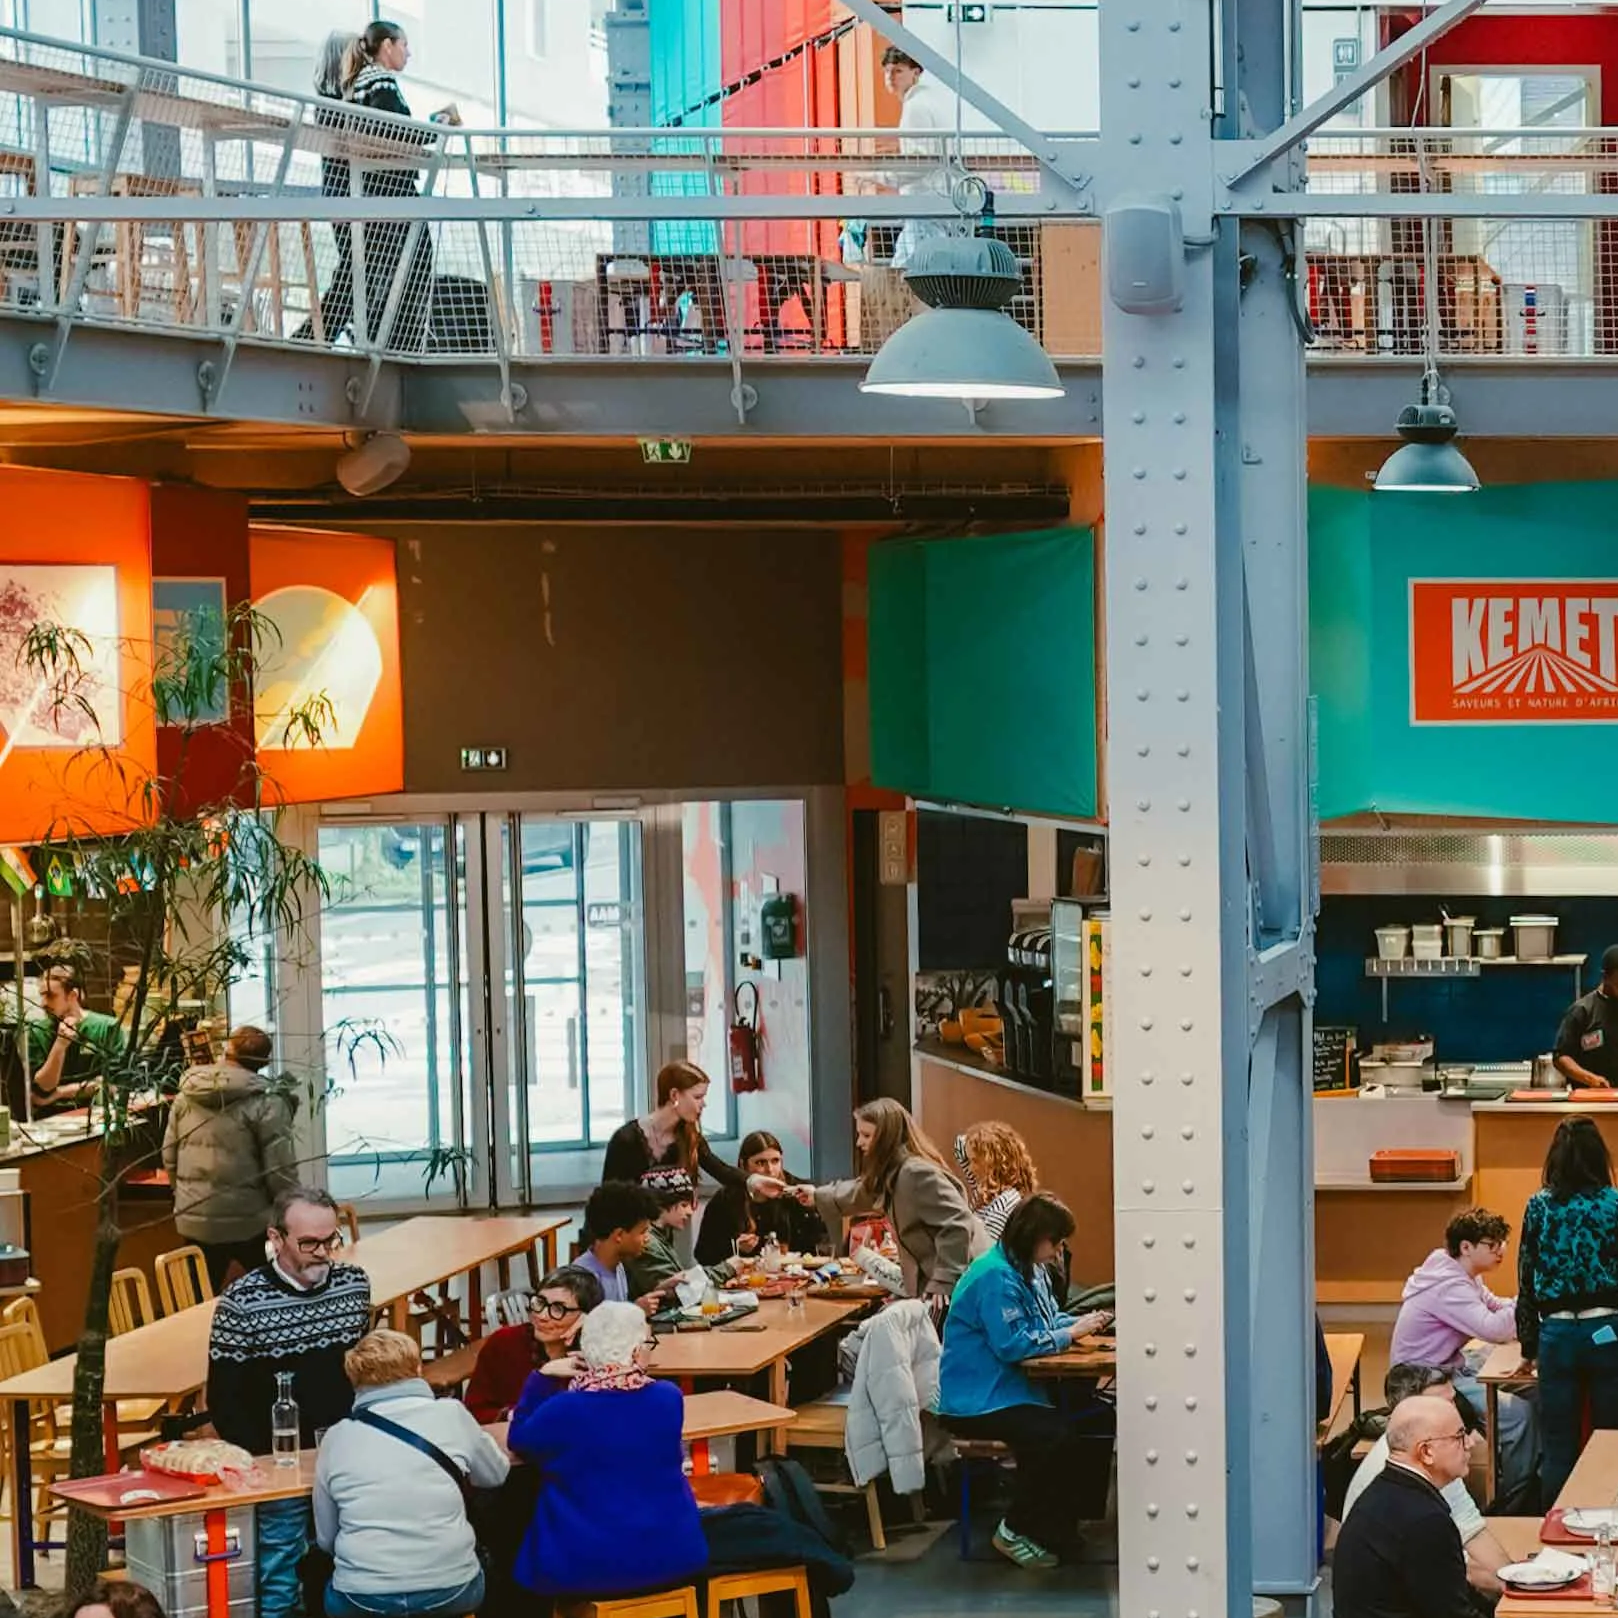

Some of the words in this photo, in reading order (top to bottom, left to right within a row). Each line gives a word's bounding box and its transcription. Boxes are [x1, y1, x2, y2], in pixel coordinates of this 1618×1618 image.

[1453, 697, 1500, 709] SAVEURS
[1507, 697, 1521, 709] ET
[1527, 697, 1568, 709] NATURE
